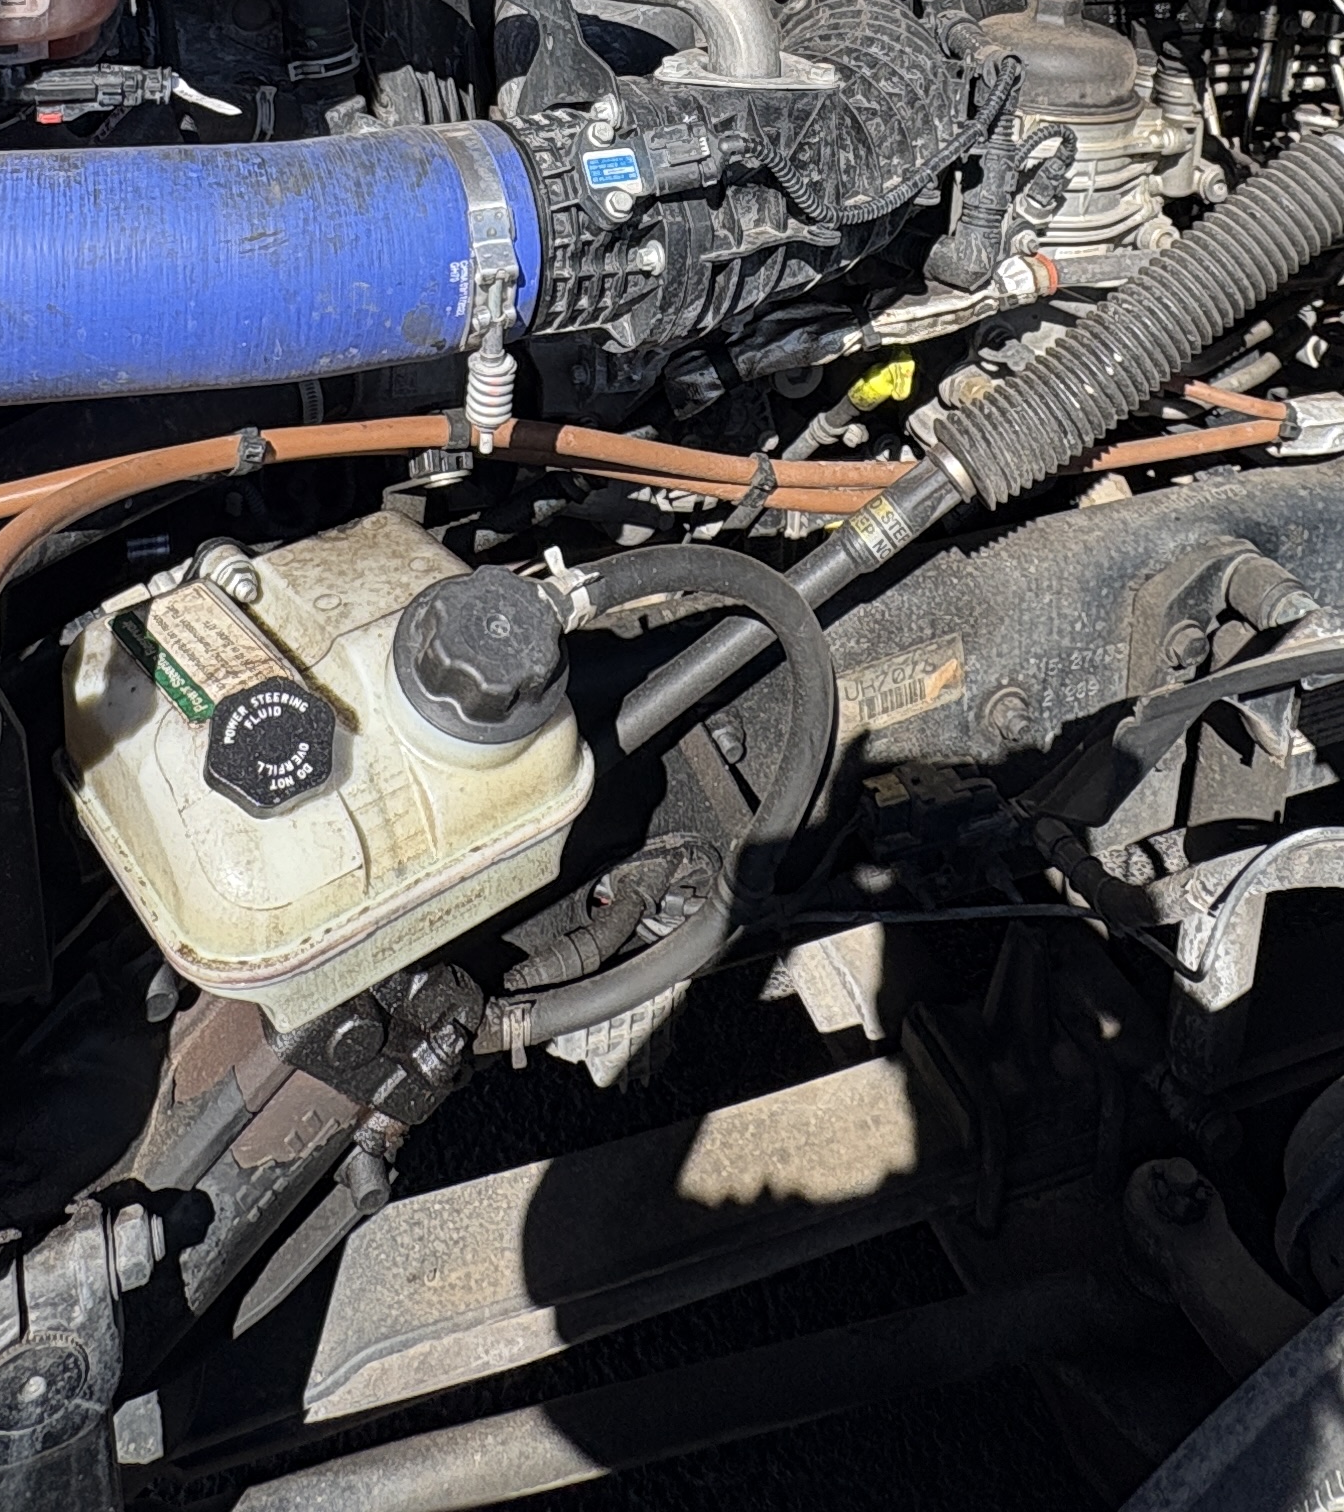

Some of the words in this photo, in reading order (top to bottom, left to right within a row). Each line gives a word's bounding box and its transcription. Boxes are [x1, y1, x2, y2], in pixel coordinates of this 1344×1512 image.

[224, 705, 248, 744] POWER
[250, 692, 309, 713] STEERING
[244, 706, 282, 730] FLUID
[257, 742, 310, 777] OVERFILL
[296, 763, 313, 779] DO
[270, 775, 295, 790] NOT
